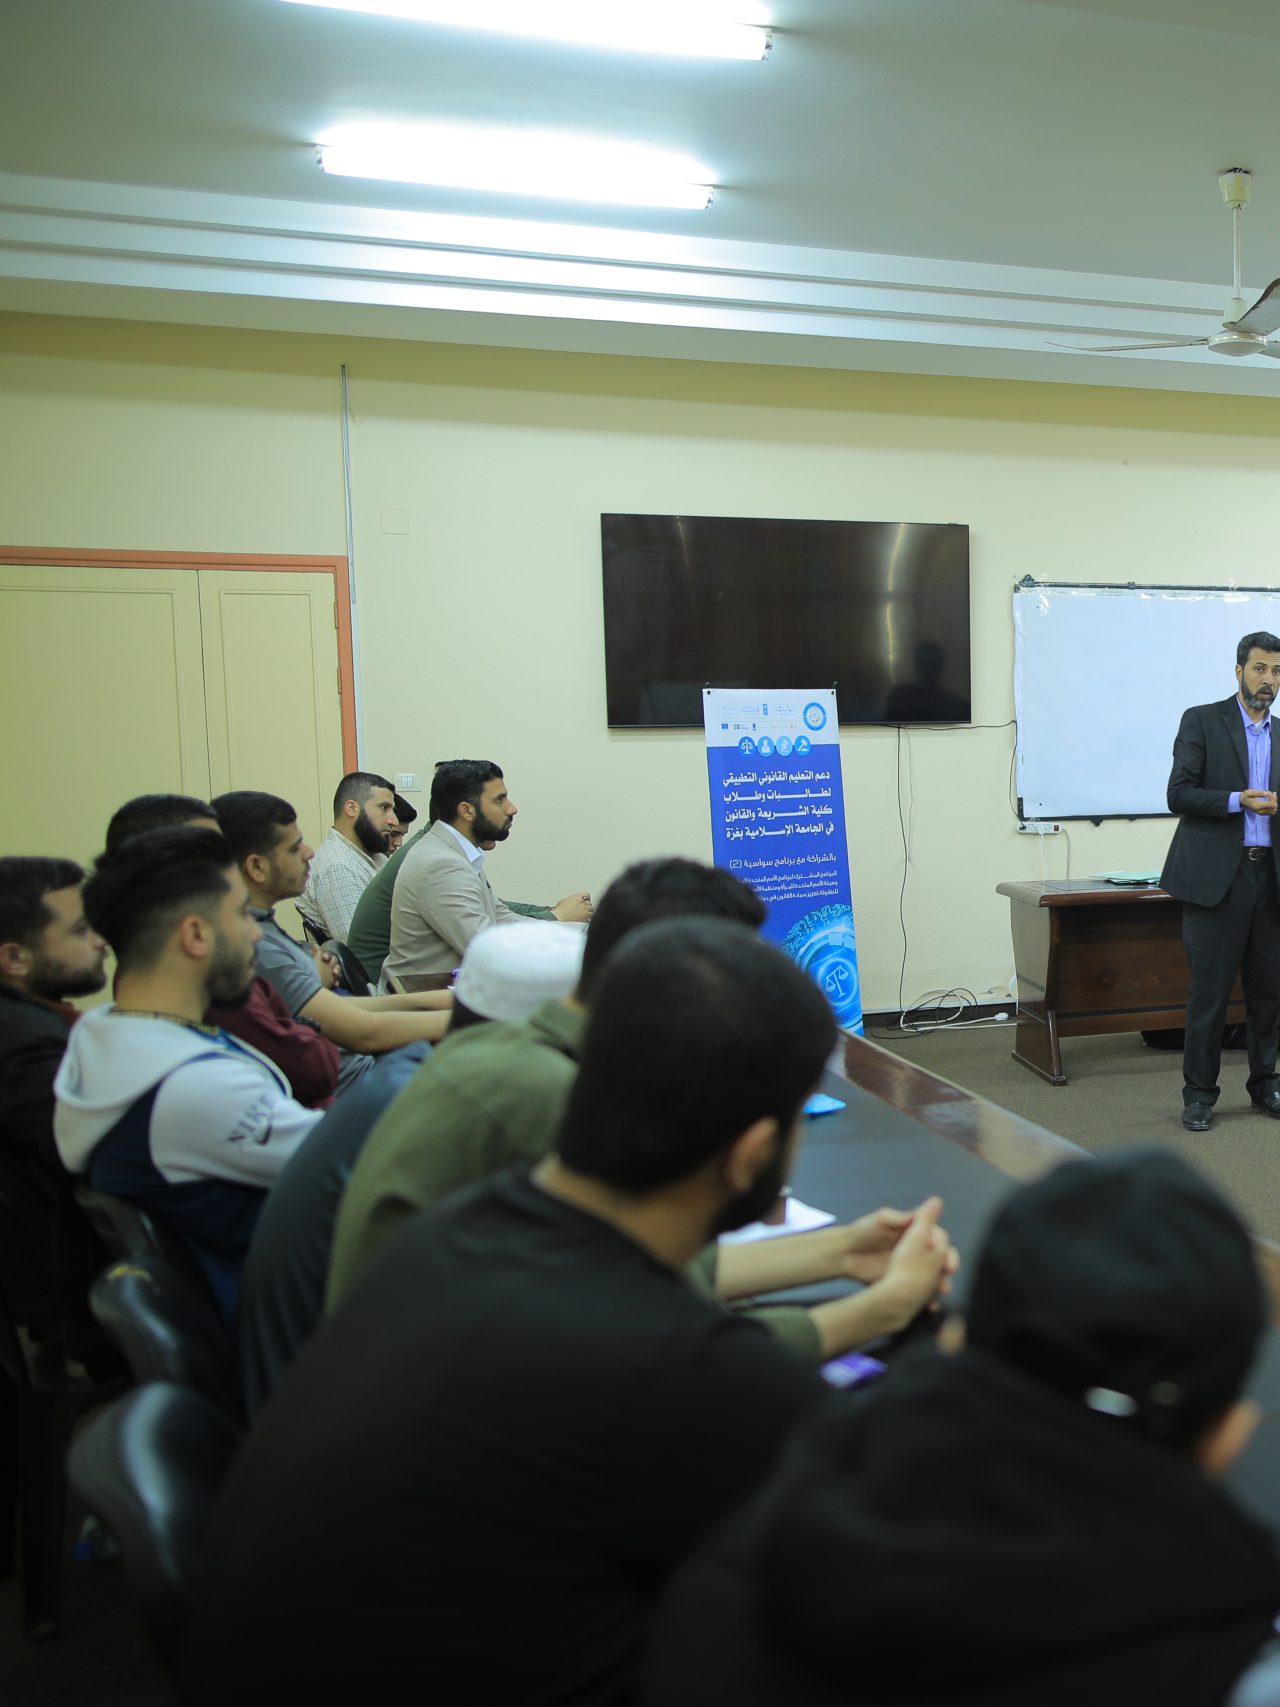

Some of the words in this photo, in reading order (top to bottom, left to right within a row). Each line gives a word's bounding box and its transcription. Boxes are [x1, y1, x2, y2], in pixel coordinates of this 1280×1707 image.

[722, 772, 757, 788] التطبيقي
[758, 770, 788, 786] القانوني
[789, 770, 814, 783] التعليم
[815, 771, 830, 782] دعم
[725, 808, 756, 822] والقانون
[757, 804, 809, 820] الشريعة
[811, 804, 833, 818] كلية
[726, 827, 743, 841] بغزة
[795, 823, 824, 835] الجامعة
[825, 821, 834, 836] في
[729, 859, 742, 870] (2)
[743, 858, 773, 869] سواسية
[774, 856, 795, 867] برنامج
[796, 856, 806, 865] مع
[807, 853, 837, 865] بالشراكة
